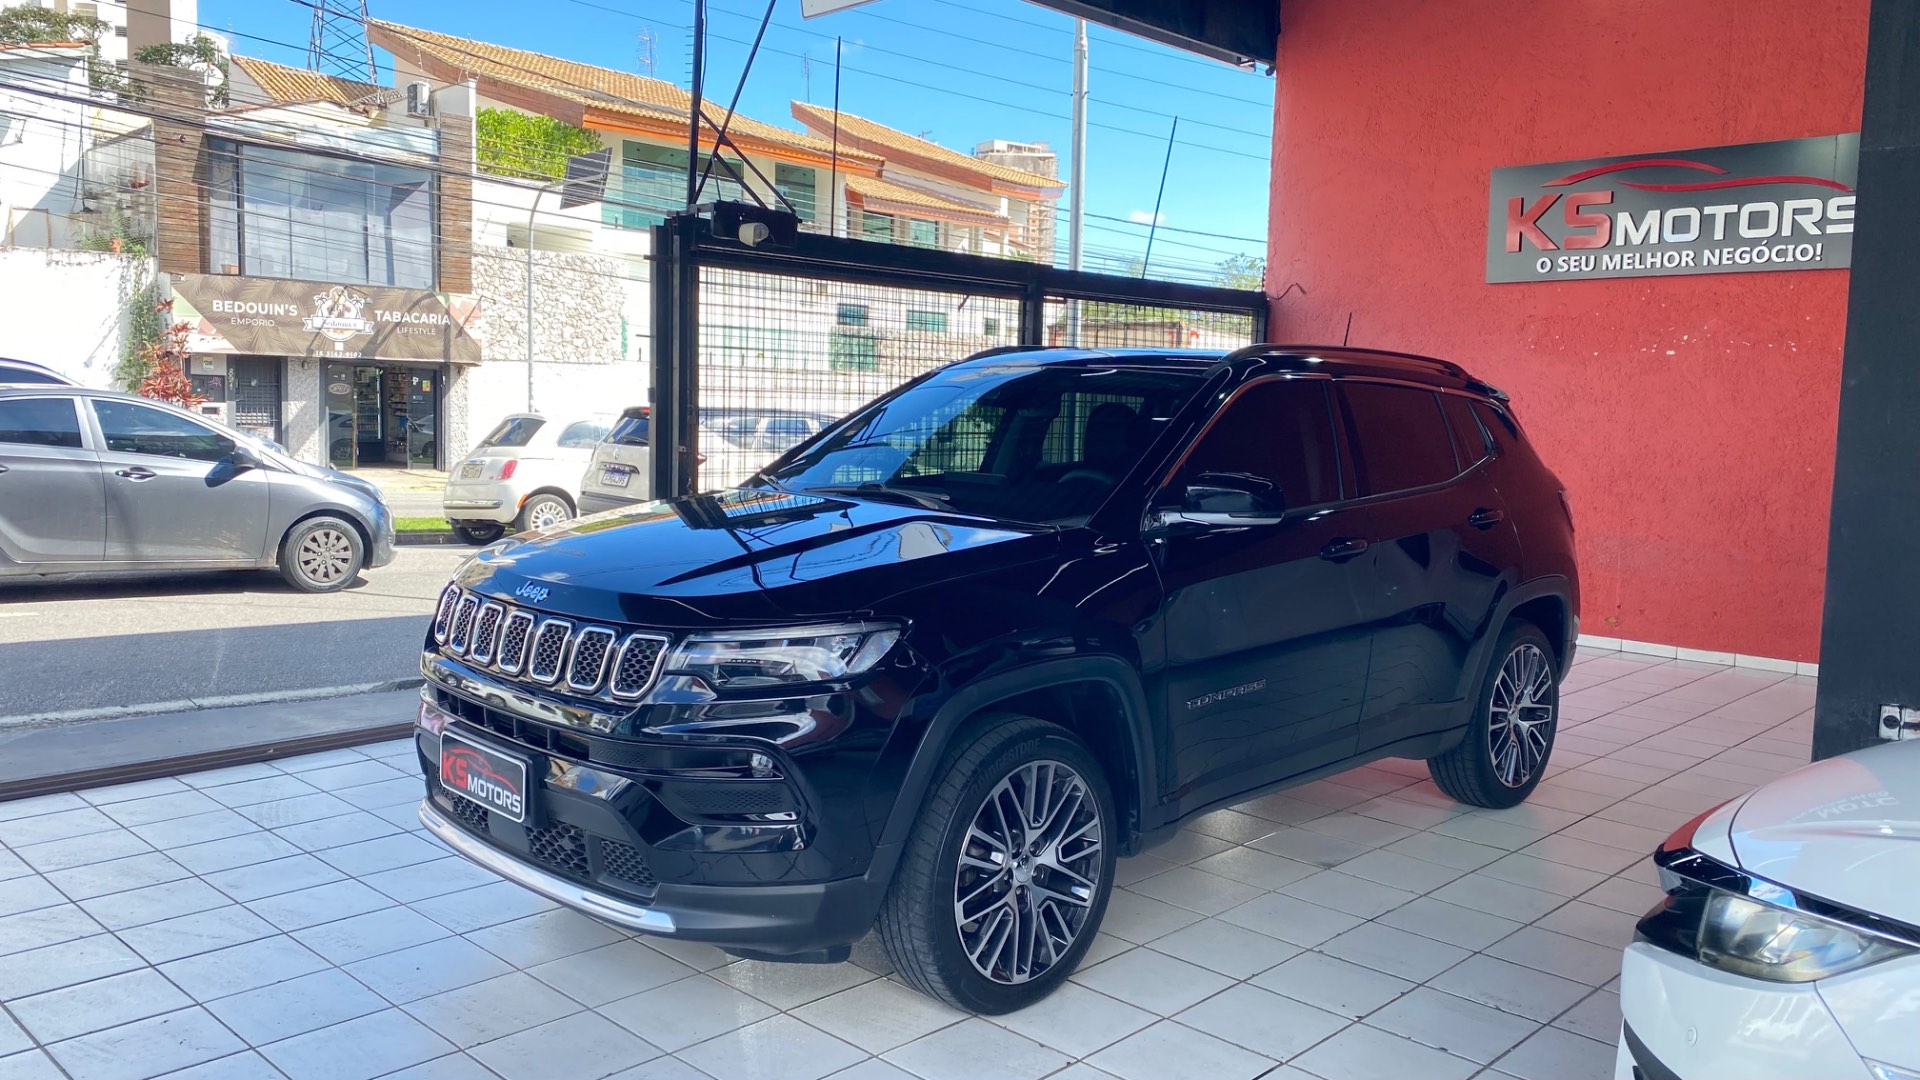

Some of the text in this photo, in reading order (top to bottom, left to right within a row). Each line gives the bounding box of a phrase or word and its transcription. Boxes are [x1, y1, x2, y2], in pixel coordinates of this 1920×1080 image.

[1536, 240, 1824, 273] O SEU MELHOR NEGÓCIO!
[212, 299, 298, 317] BEDOUIN'S
[230, 317, 275, 327] EMPORIO
[374, 310, 451, 326] TABACARIA
[396, 326, 437, 336] LIFESTYLE
[515, 580, 549, 604] Jeep
[467, 773, 521, 814] MOTORS
